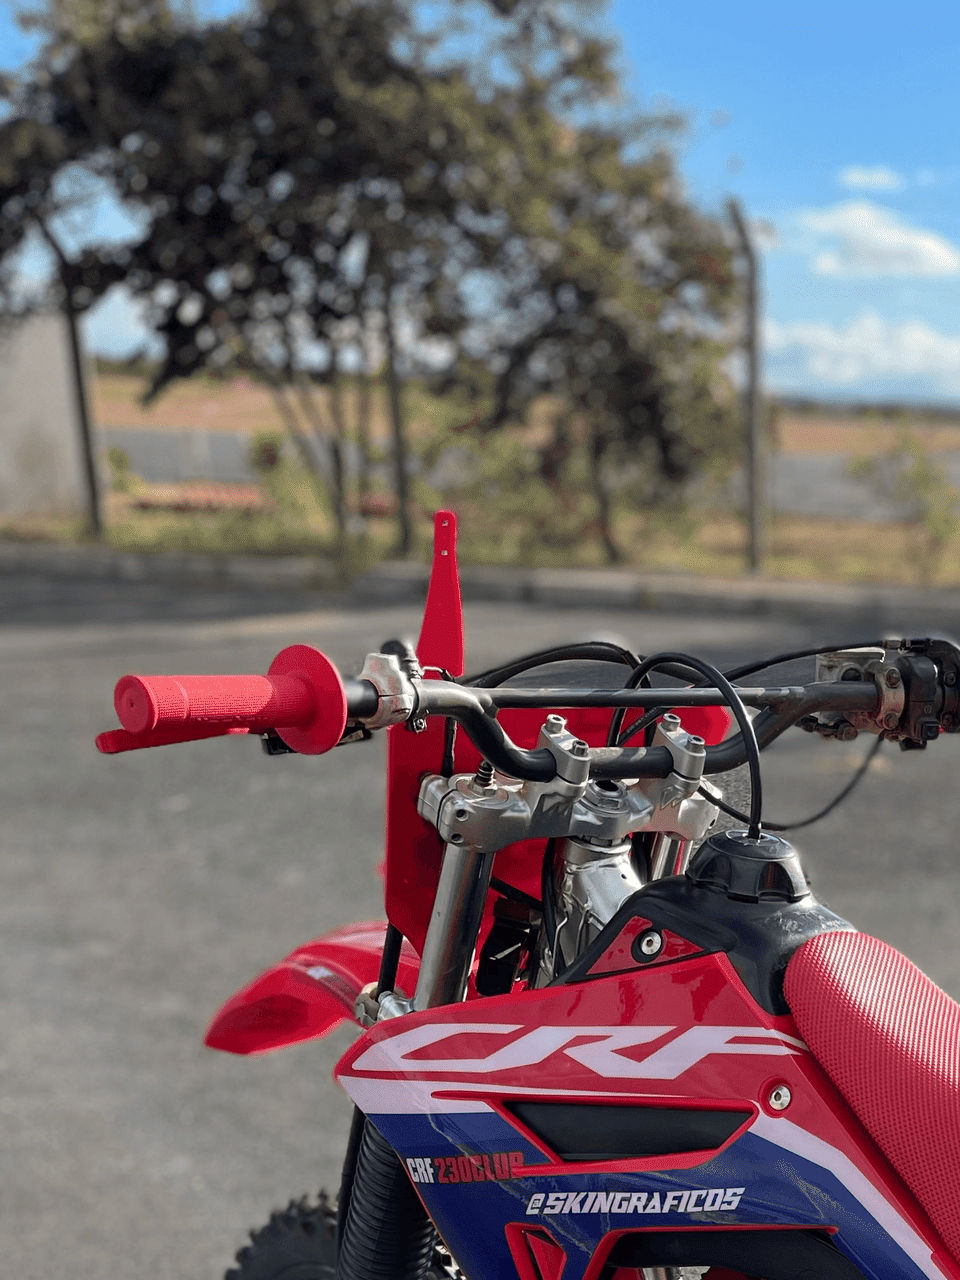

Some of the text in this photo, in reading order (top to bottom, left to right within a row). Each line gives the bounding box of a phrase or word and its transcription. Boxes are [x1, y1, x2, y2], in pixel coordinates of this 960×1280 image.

[351, 1023, 809, 1080] CRF
[405, 1157, 435, 1183] CRF
[526, 1188, 745, 1215] @SKINGRAFICOS
